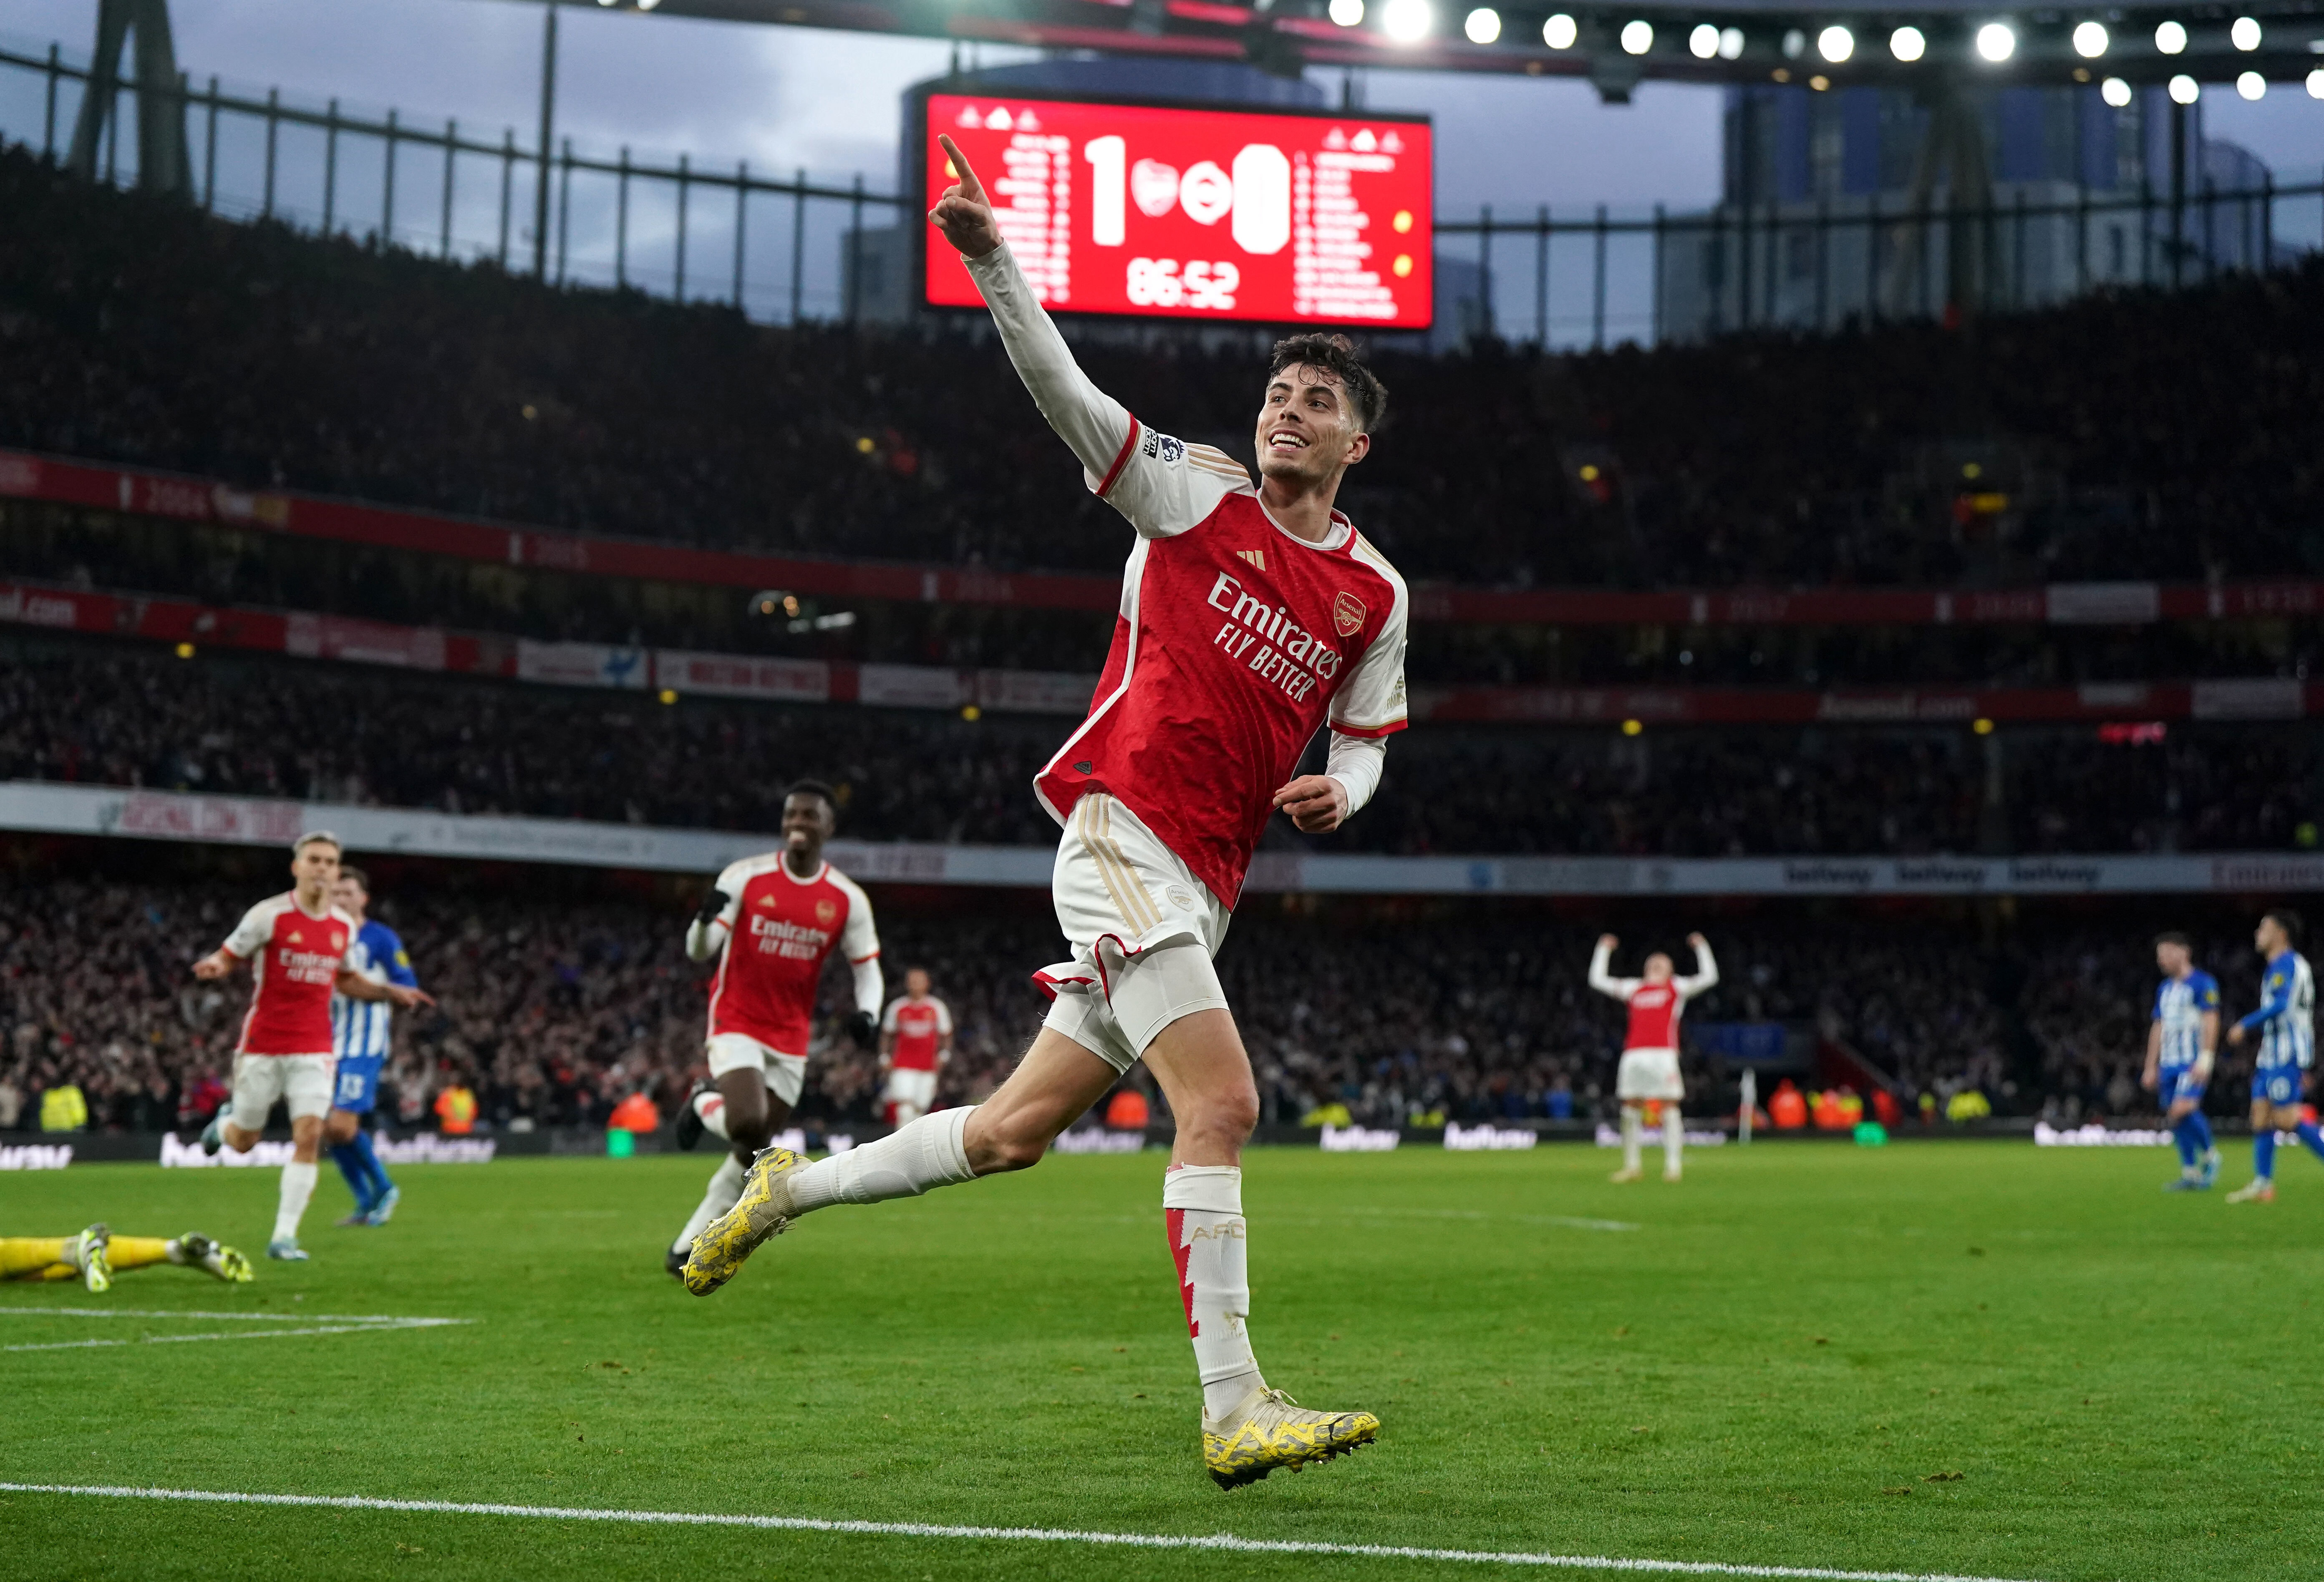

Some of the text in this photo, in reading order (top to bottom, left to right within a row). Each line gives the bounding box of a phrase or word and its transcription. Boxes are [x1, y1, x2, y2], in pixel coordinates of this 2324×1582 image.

[1085, 135, 1125, 247] 1
[1231, 143, 1291, 255] 0
[1127, 257, 1240, 310] 86:52
[1207, 571, 1342, 680] Emirates
[1340, 598, 1361, 615] Arsenal
[1214, 622, 1316, 702] FLY BETTER
[1191, 1223, 1245, 1243] AFC
